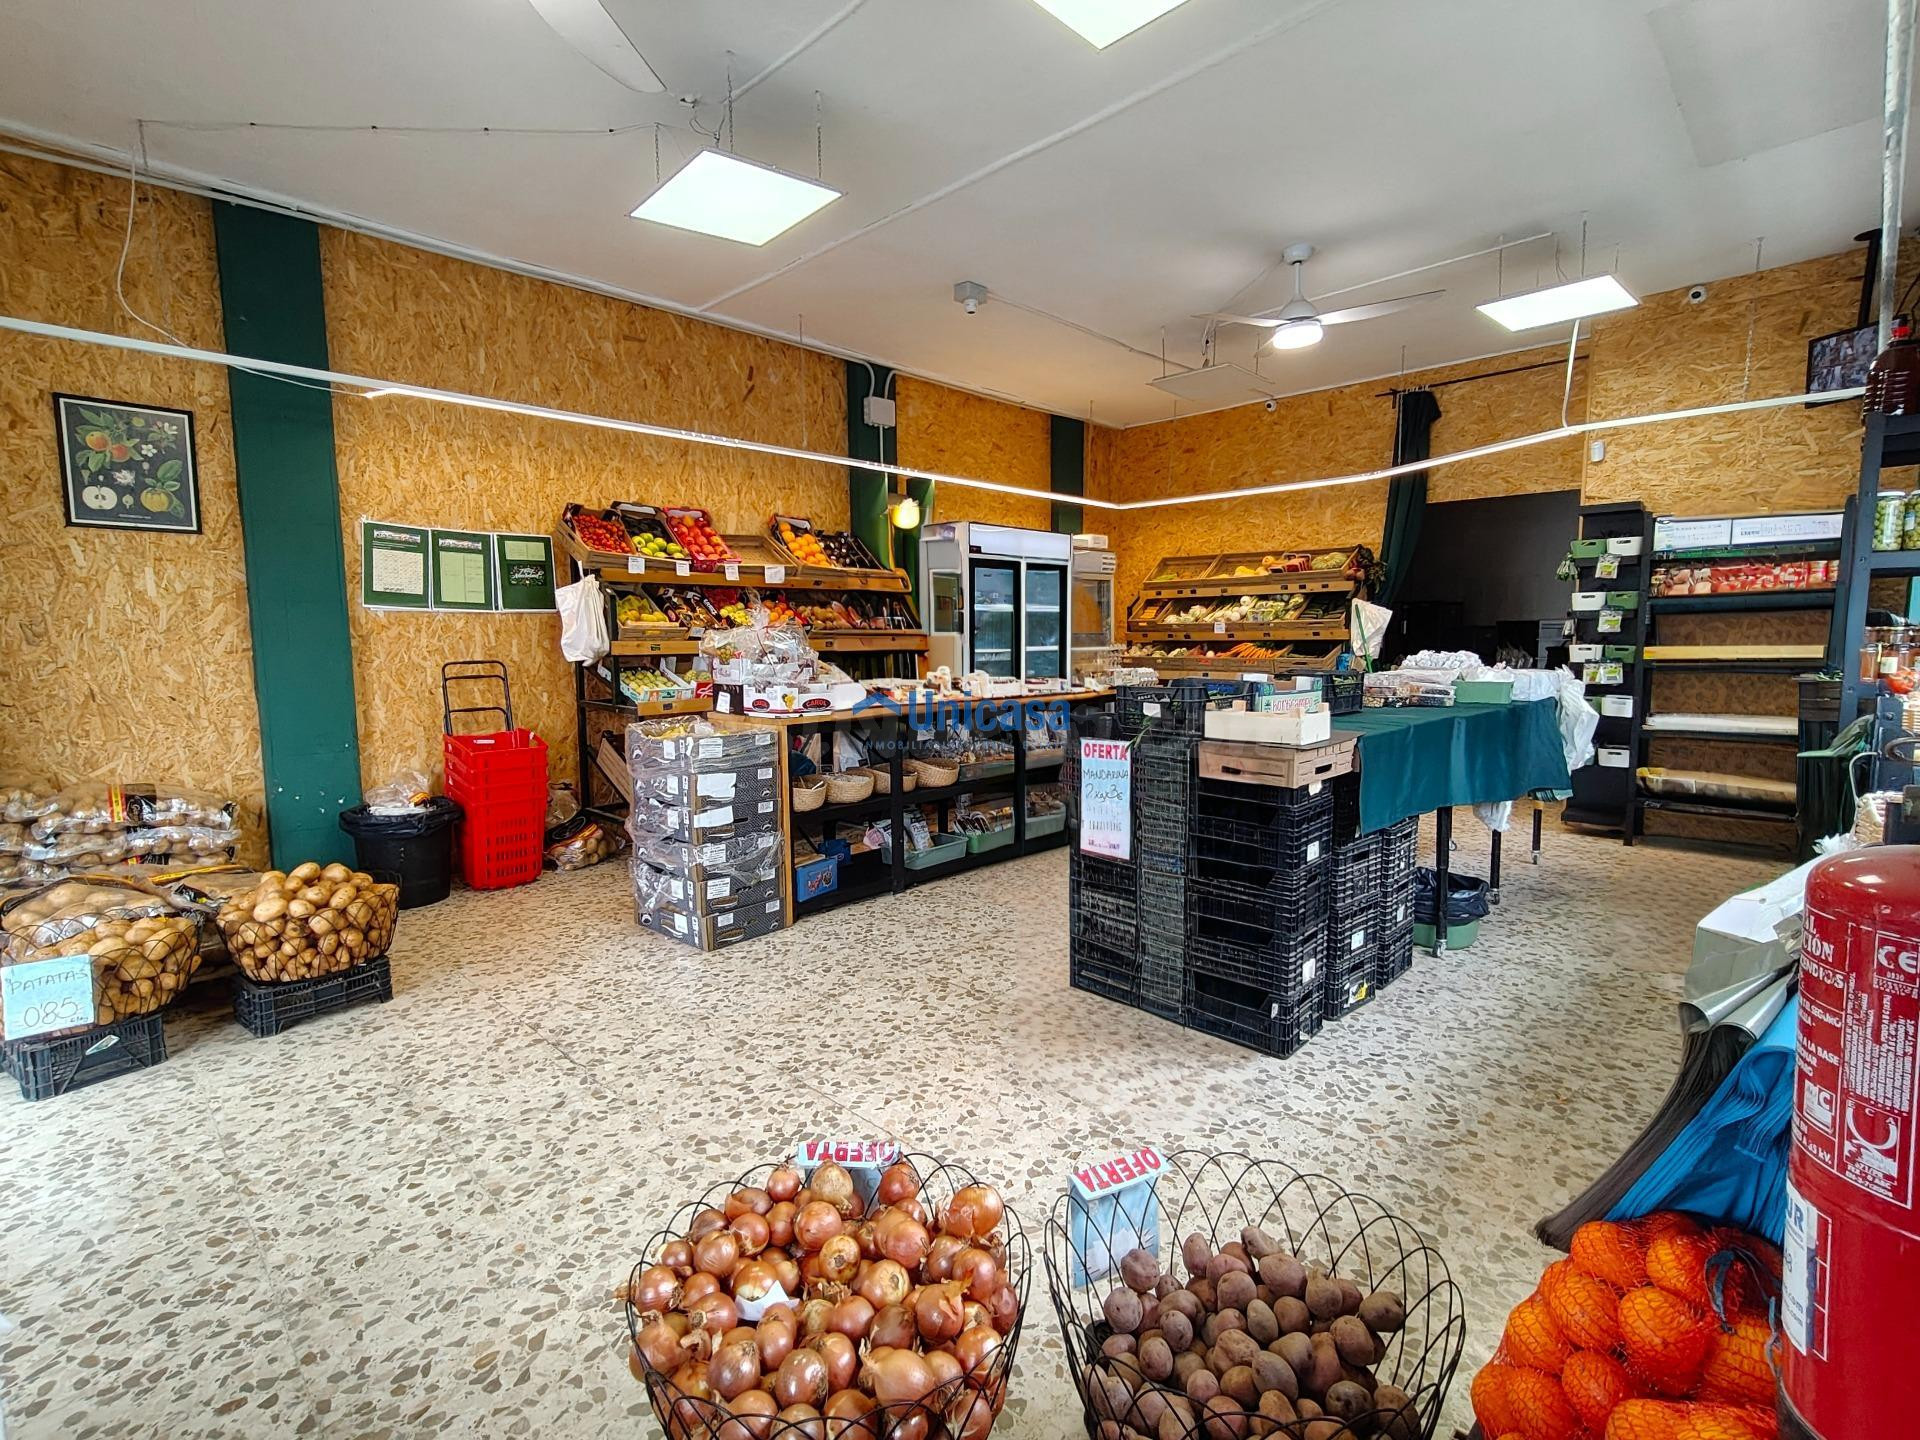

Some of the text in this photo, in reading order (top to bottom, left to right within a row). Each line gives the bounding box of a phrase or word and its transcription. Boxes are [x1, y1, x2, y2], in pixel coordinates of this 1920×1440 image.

[1084, 743, 1127, 760] OFERTA
[7, 968, 89, 995] PATATAS
[1817, 1046, 1839, 1066] BASE
[806, 1141, 894, 1162] OFERTA
[1073, 1147, 1162, 1192] OFERTA
